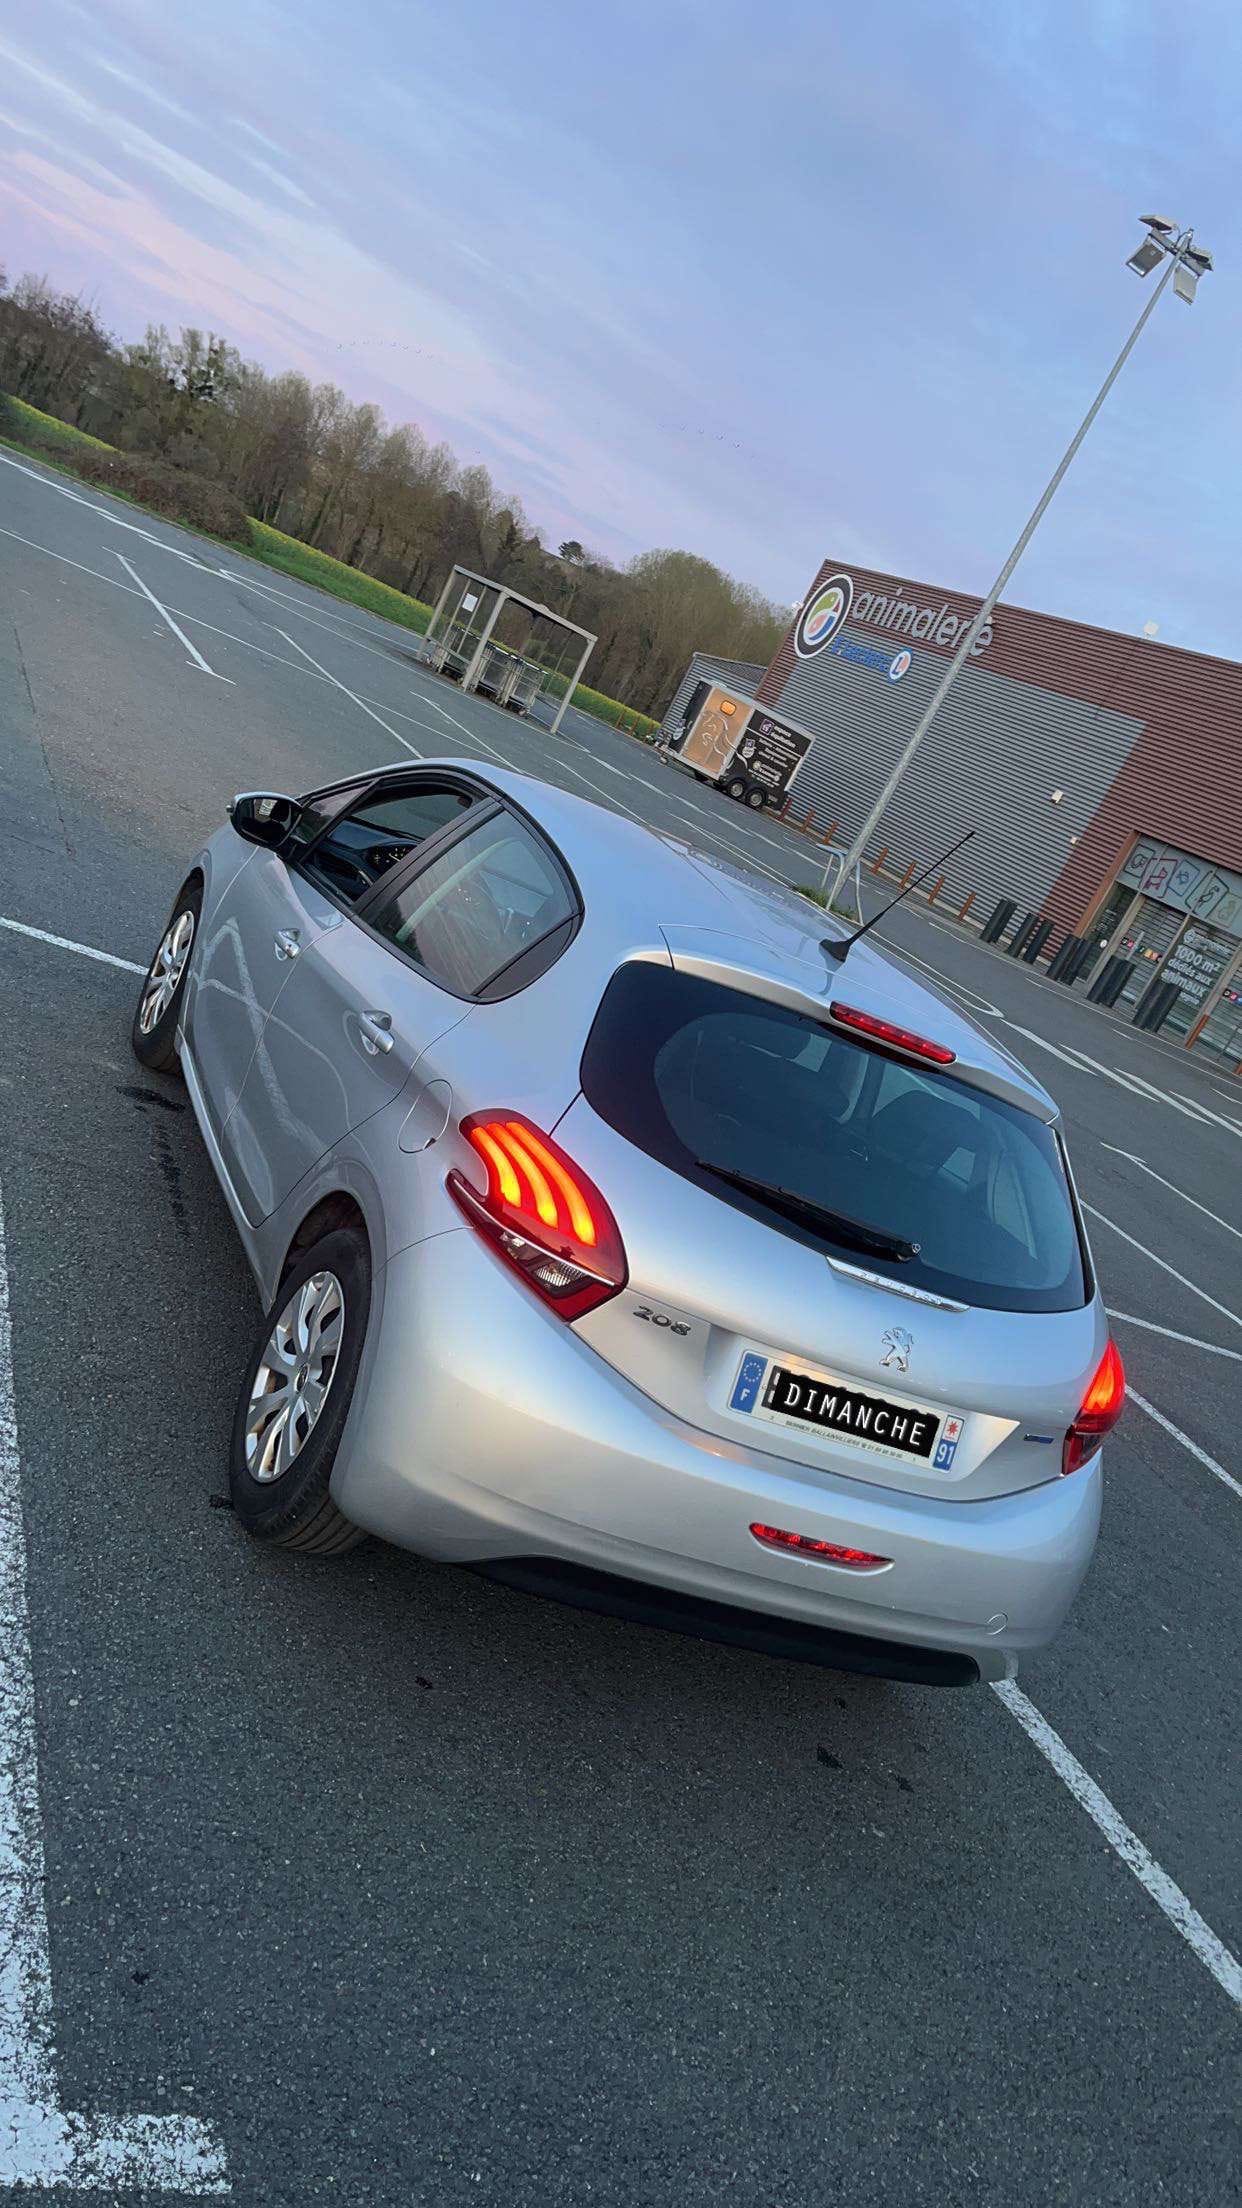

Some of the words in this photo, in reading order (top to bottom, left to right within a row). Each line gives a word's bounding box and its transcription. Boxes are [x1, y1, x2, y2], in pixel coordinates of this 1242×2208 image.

[852, 587, 994, 656] animalere
[1175, 945, 1203, 966] 1000
[1160, 969, 1206, 998] animaux
[1195, 974, 1213, 985] aux
[633, 1305, 691, 1336] 208
[740, 1388, 750, 1401] F
[936, 1443, 954, 1465] 91
